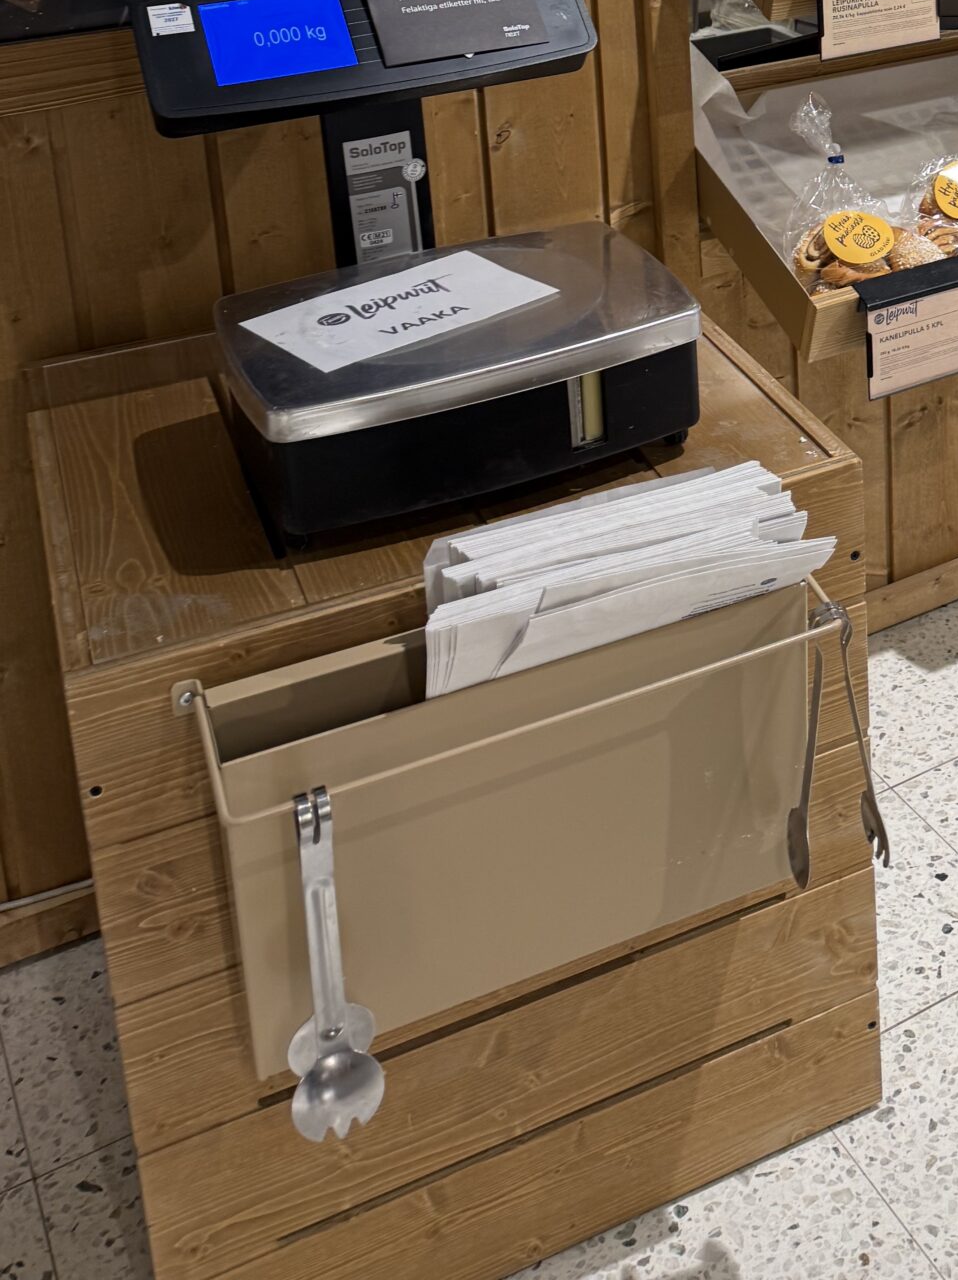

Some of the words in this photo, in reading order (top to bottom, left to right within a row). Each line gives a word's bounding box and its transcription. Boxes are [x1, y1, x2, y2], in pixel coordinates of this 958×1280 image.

[401, 4, 438, 14] Felaktiga
[439, 0, 472, 9] etiketter
[832, 1, 879, 13] RUSINAPULLA
[254, 25, 301, 48] 0,000
[306, 25, 327, 41] kg
[349, 141, 406, 159] SoloTop
[345, 273, 453, 320] Leipurit
[379, 305, 471, 335] VAAKA
[886, 299, 924, 326] Leipurit
[880, 326, 924, 343] KANELIPULLA
